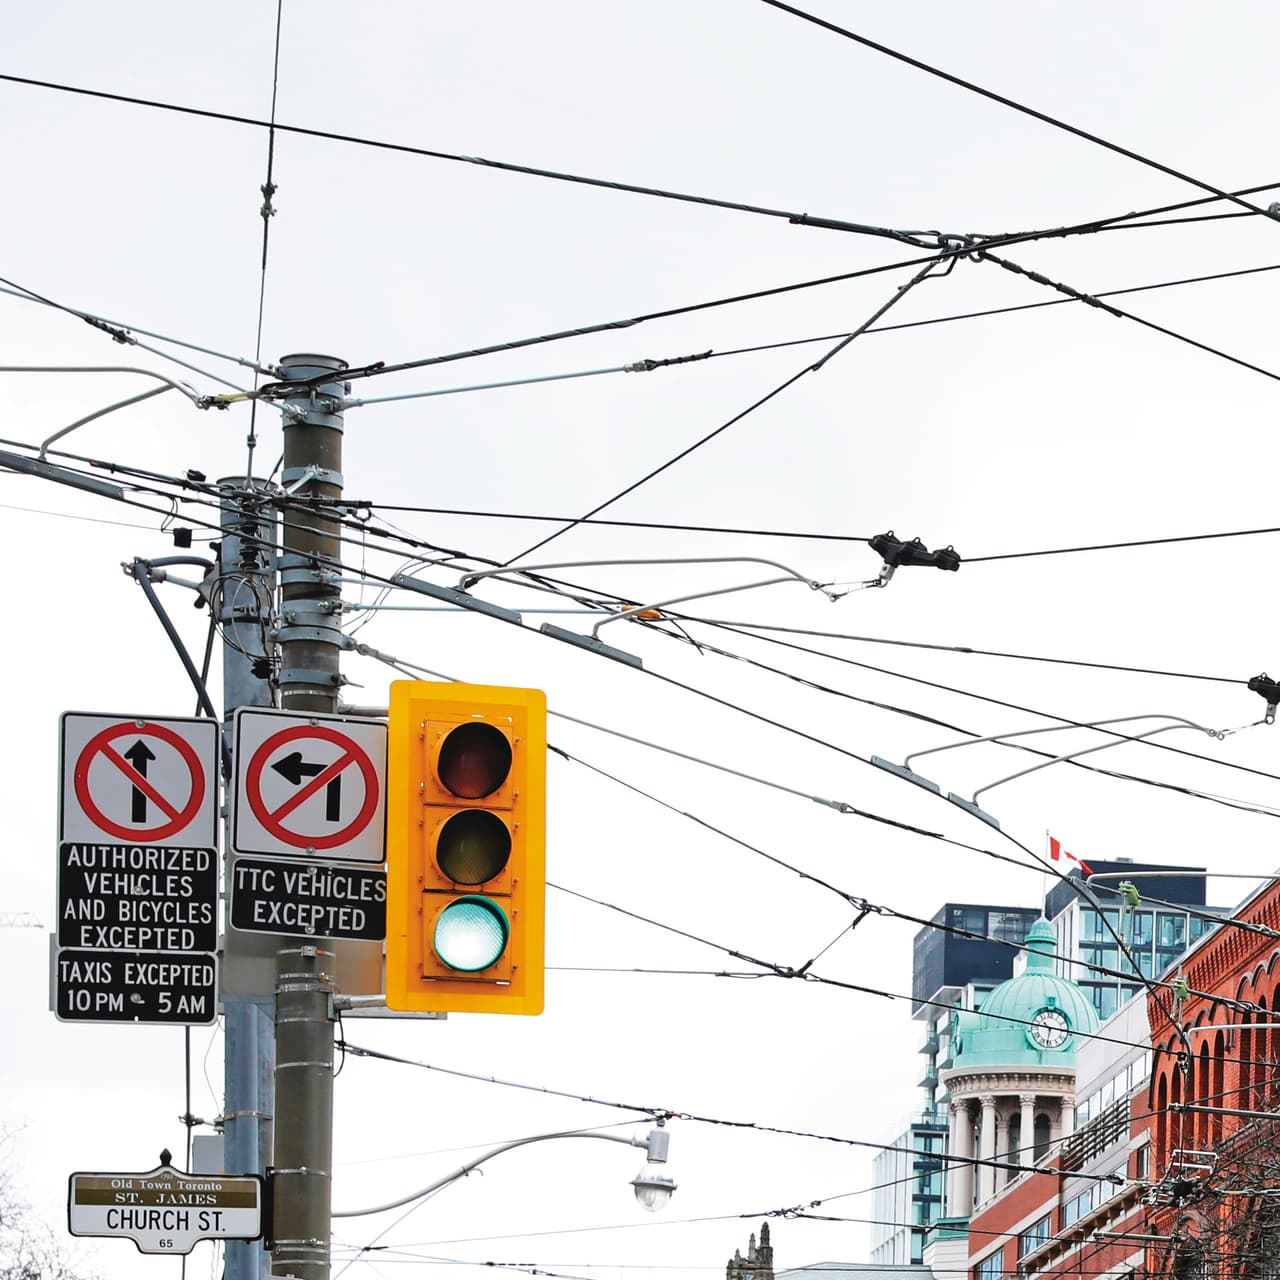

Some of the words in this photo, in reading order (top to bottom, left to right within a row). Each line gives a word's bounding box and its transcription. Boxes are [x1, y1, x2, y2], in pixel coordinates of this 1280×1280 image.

[67, 846, 210, 871] AUTHORIZED
[84, 872, 193, 897] VEHICLES
[236, 867, 276, 893] TTC
[283, 870, 387, 902] VEHICLES
[64, 899, 106, 921] AND
[119, 900, 212, 924] BICYCLES
[254, 902, 366, 932] EXCEPTED
[80, 925, 195, 950] EXCEPTED
[60, 960, 112, 985] TAXIS
[125, 961, 214, 987] EXCEPTED
[111, 1179, 133, 1190] Old
[139, 1180, 172, 1191] Town
[177, 1181, 222, 1192] Toronto
[115, 1192, 144, 1204] ST.
[156, 1194, 217, 1205] JAMES
[107, 1209, 189, 1231] CHURCH
[198, 1211, 226, 1232] ST.
[159, 1239, 174, 1249] 65
